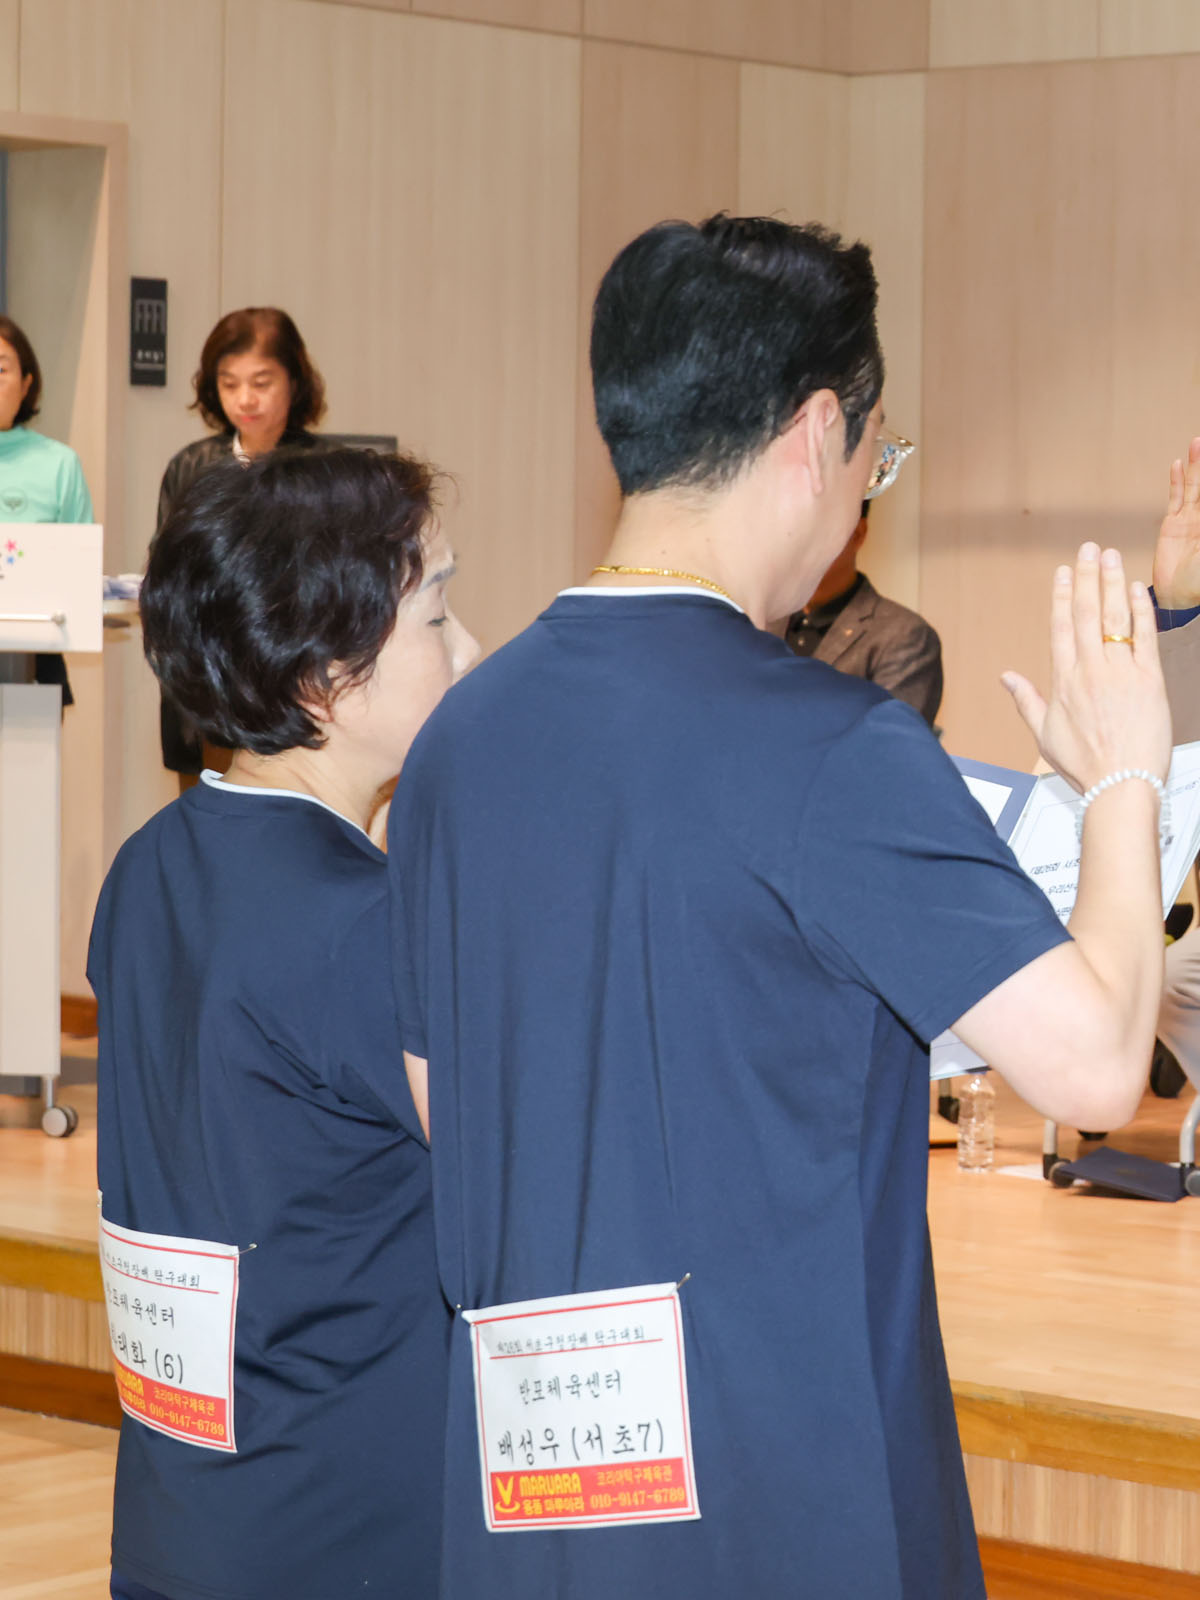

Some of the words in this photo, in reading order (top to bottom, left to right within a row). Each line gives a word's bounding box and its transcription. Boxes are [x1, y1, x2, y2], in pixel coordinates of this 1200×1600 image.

[595, 1325, 645, 1345] 탁구대회
[154, 1348, 184, 1385] (6)
[518, 1369, 622, 1406] 반포체육센터
[149, 1402, 225, 1437] 010-9147-6789
[498, 1427, 560, 1466] 배성우
[571, 1418, 664, 1461] (서초7)
[590, 1486, 686, 1510] 010-9147-6789
